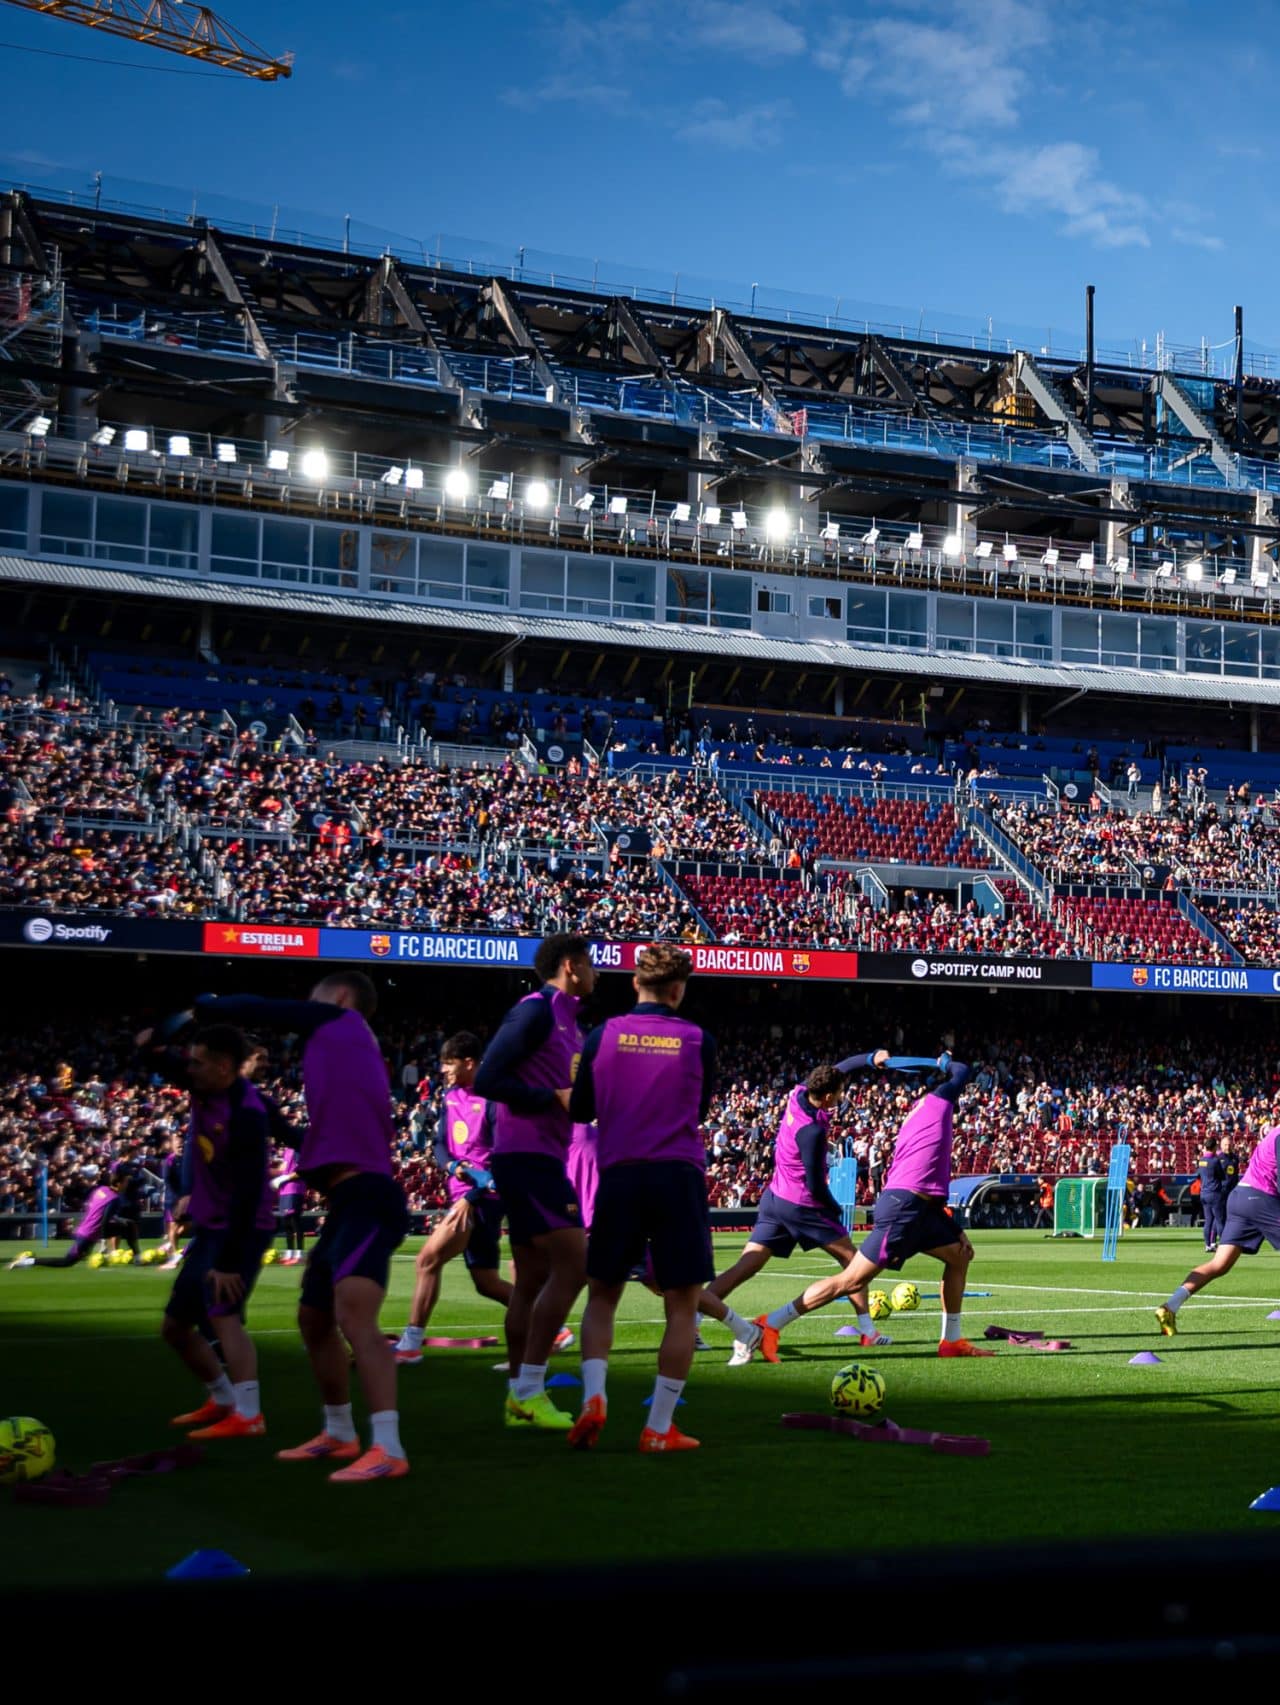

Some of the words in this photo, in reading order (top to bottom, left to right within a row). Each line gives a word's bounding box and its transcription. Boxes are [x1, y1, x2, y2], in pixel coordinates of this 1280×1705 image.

[55, 924, 109, 941] Spotify
[241, 932, 304, 946] ESTRELLA
[399, 935, 419, 957] FC
[423, 937, 519, 961] BARCELONA
[588, 944, 622, 966] 4:45
[697, 949, 784, 972] BARCELONA
[929, 962, 979, 977] SPOTIFY
[981, 964, 1015, 978] CAMP
[1016, 966, 1042, 979] NOU
[1154, 968, 1171, 987] FC
[1173, 969, 1249, 990] BARCELONA
